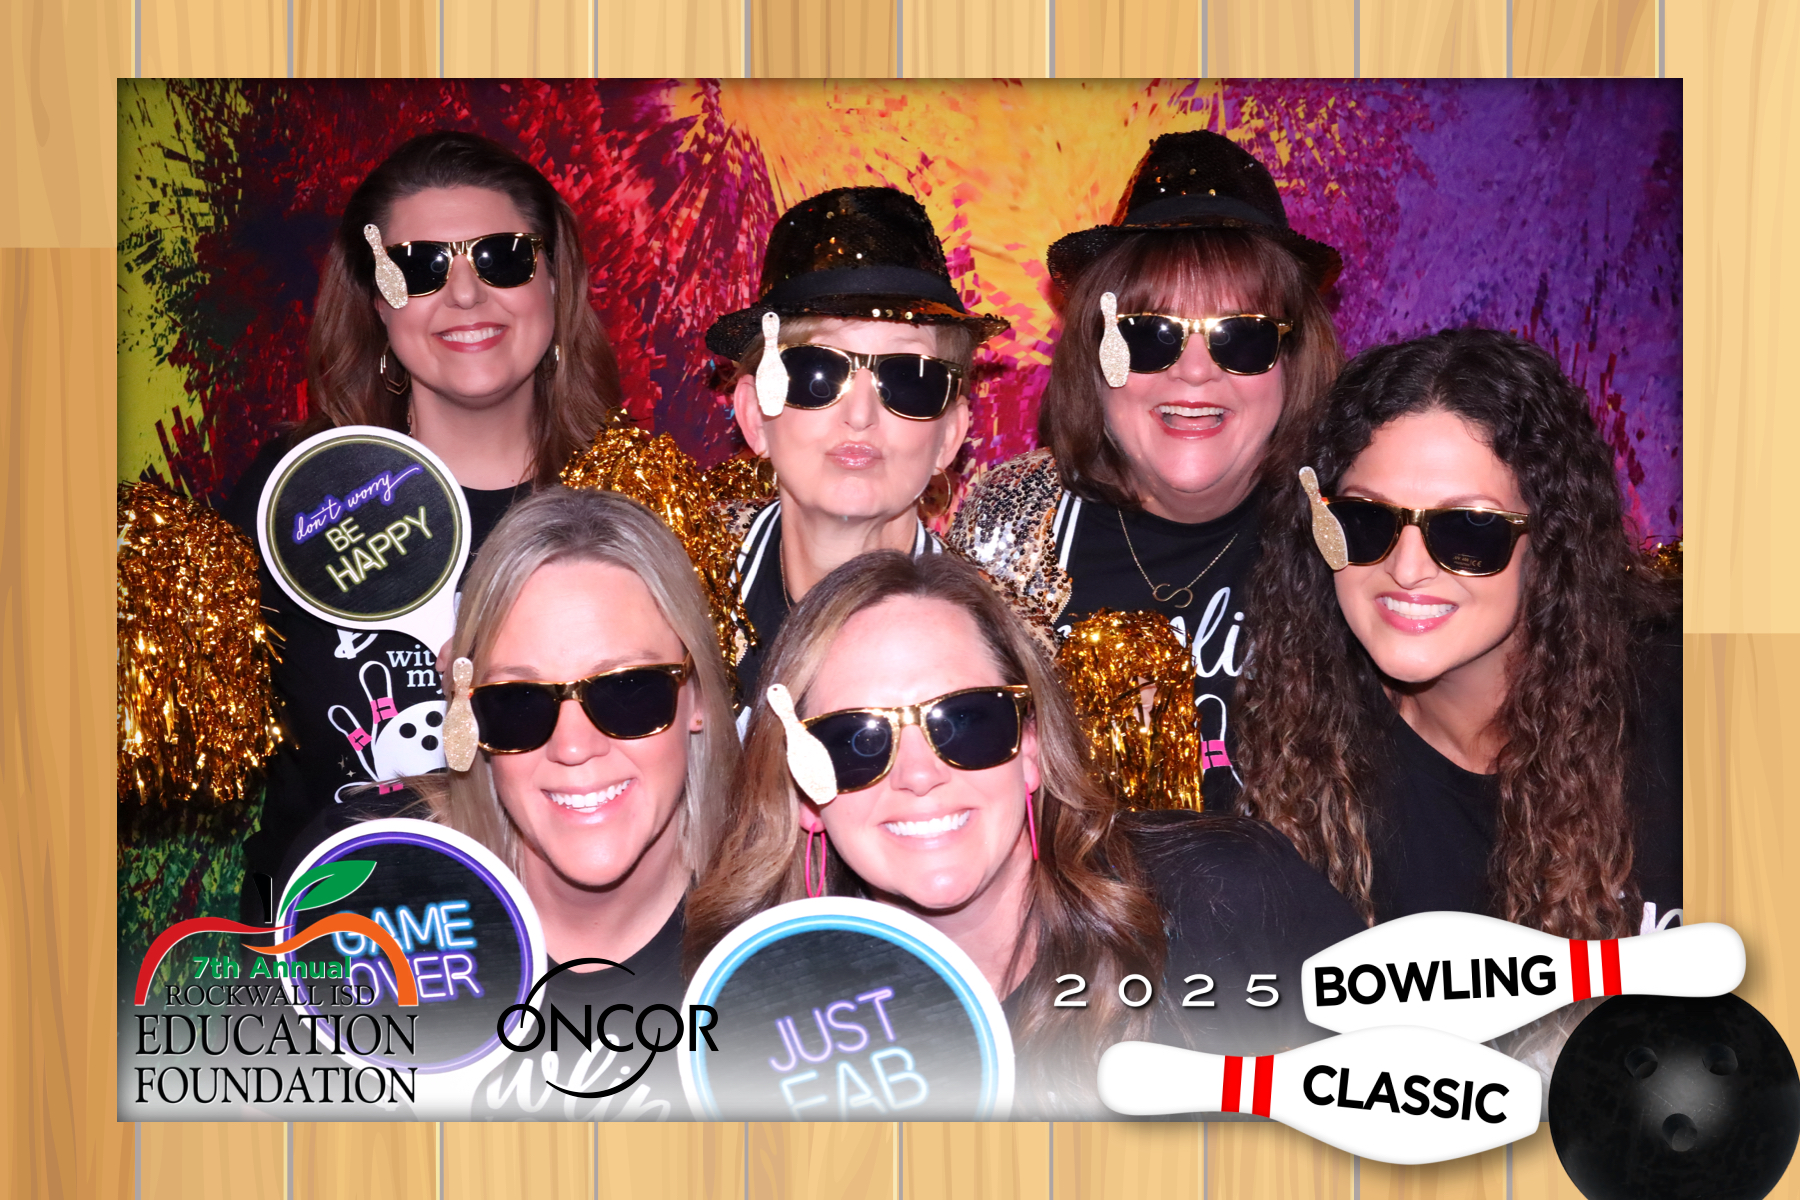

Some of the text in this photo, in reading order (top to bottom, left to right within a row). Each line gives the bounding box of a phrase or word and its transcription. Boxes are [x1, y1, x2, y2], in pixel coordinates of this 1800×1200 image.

[347, 466, 421, 503] worry
[323, 516, 367, 553] BE
[325, 505, 434, 593] HAPPY
[385, 644, 435, 668] wit
[333, 902, 476, 957] GAME
[769, 987, 895, 1073] JUST
[779, 1046, 930, 1121] FAB
